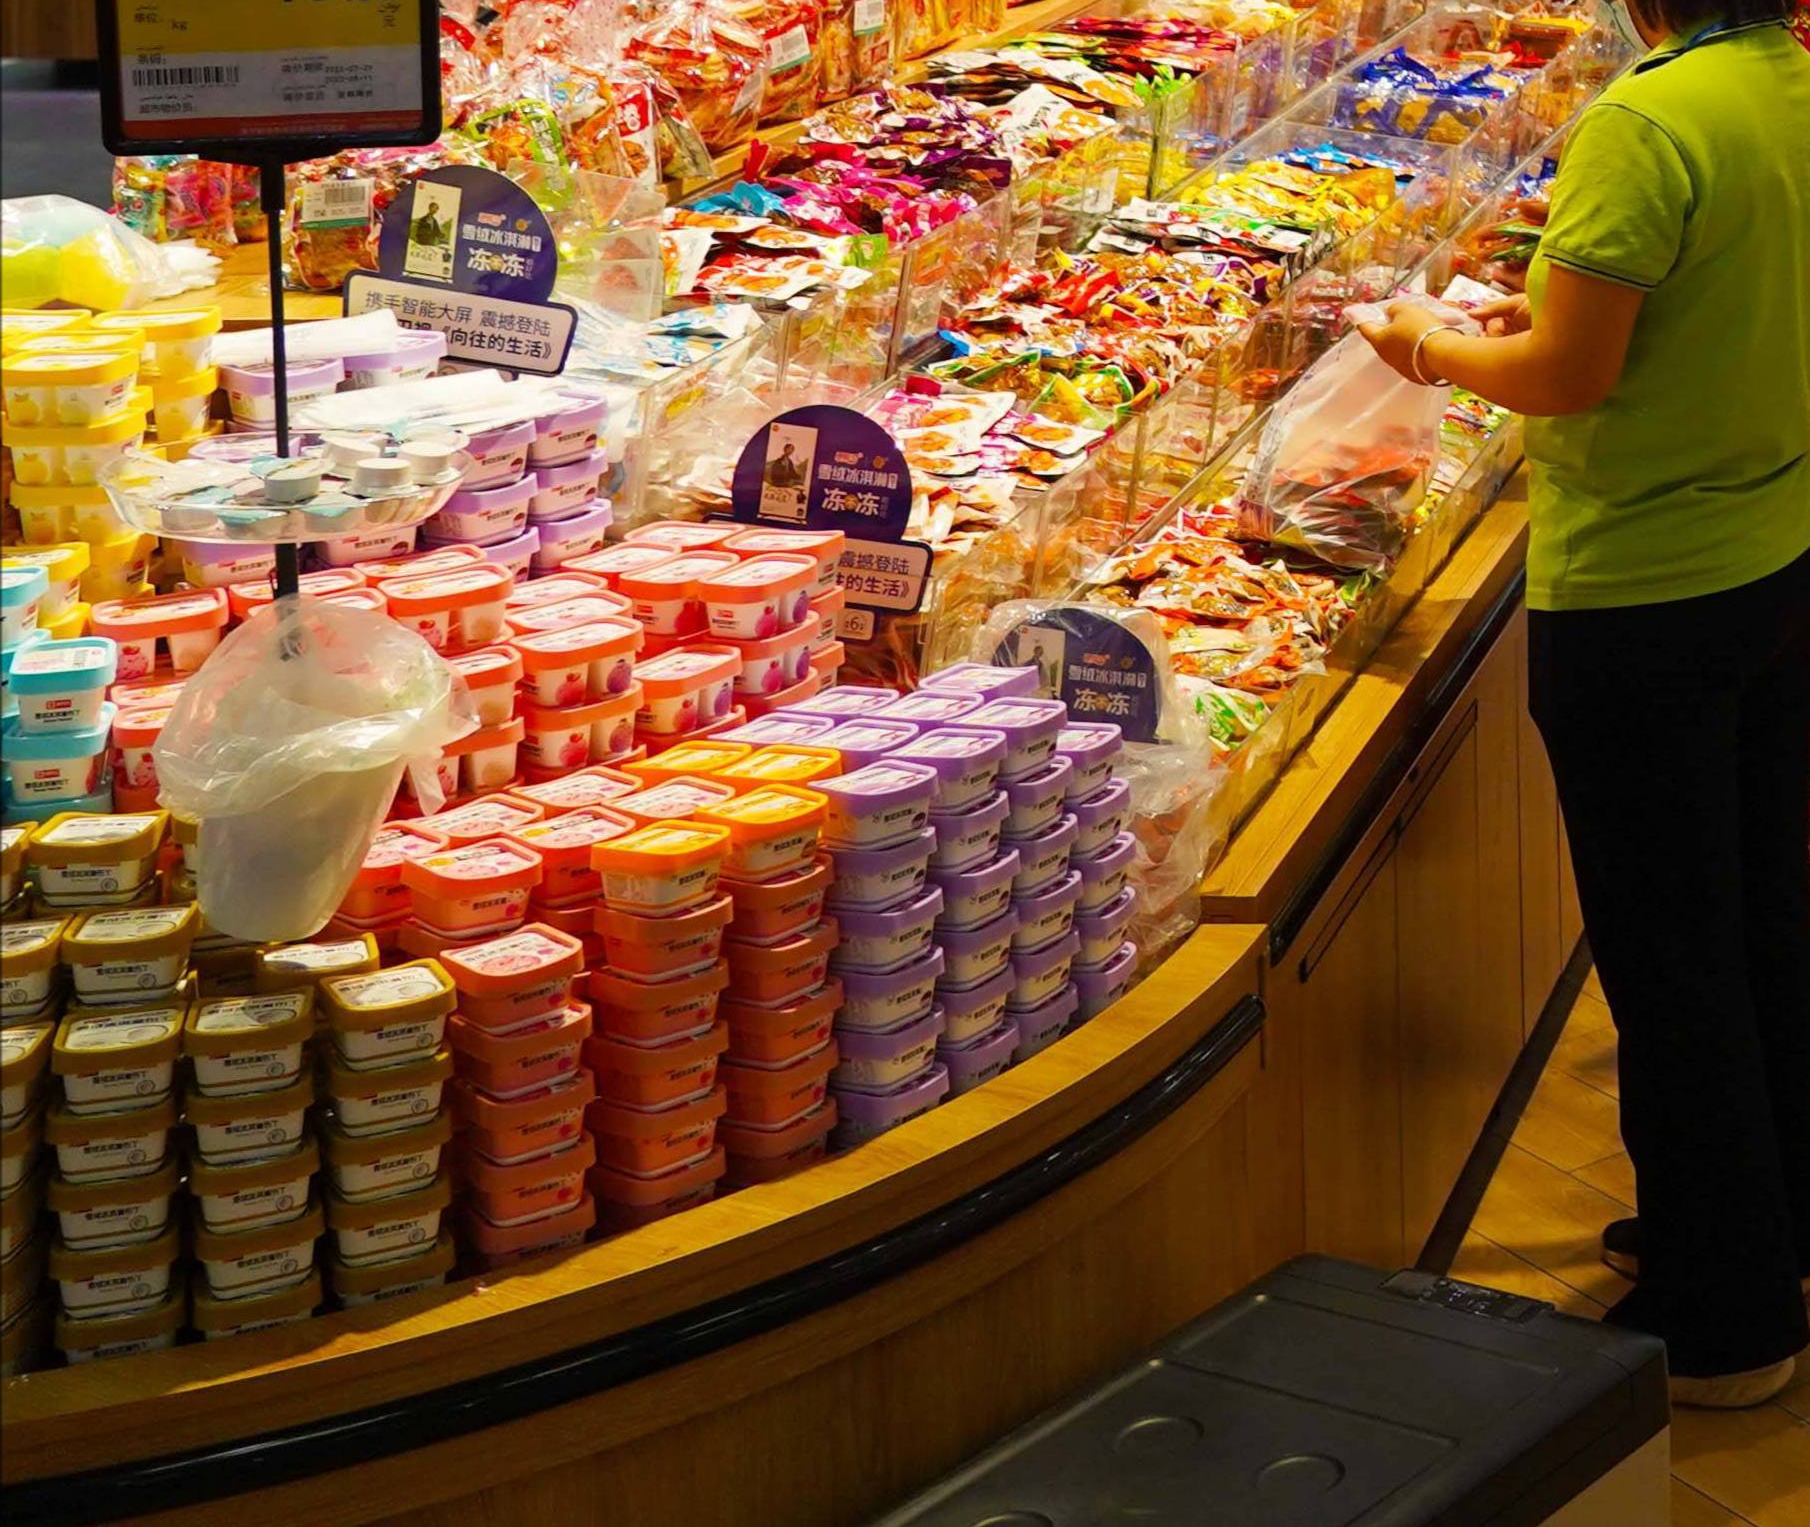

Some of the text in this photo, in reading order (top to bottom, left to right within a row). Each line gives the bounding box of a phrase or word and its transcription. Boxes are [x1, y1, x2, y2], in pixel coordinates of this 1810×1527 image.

[364, 290, 552, 337] 携手智能大屏 震撼登陆
